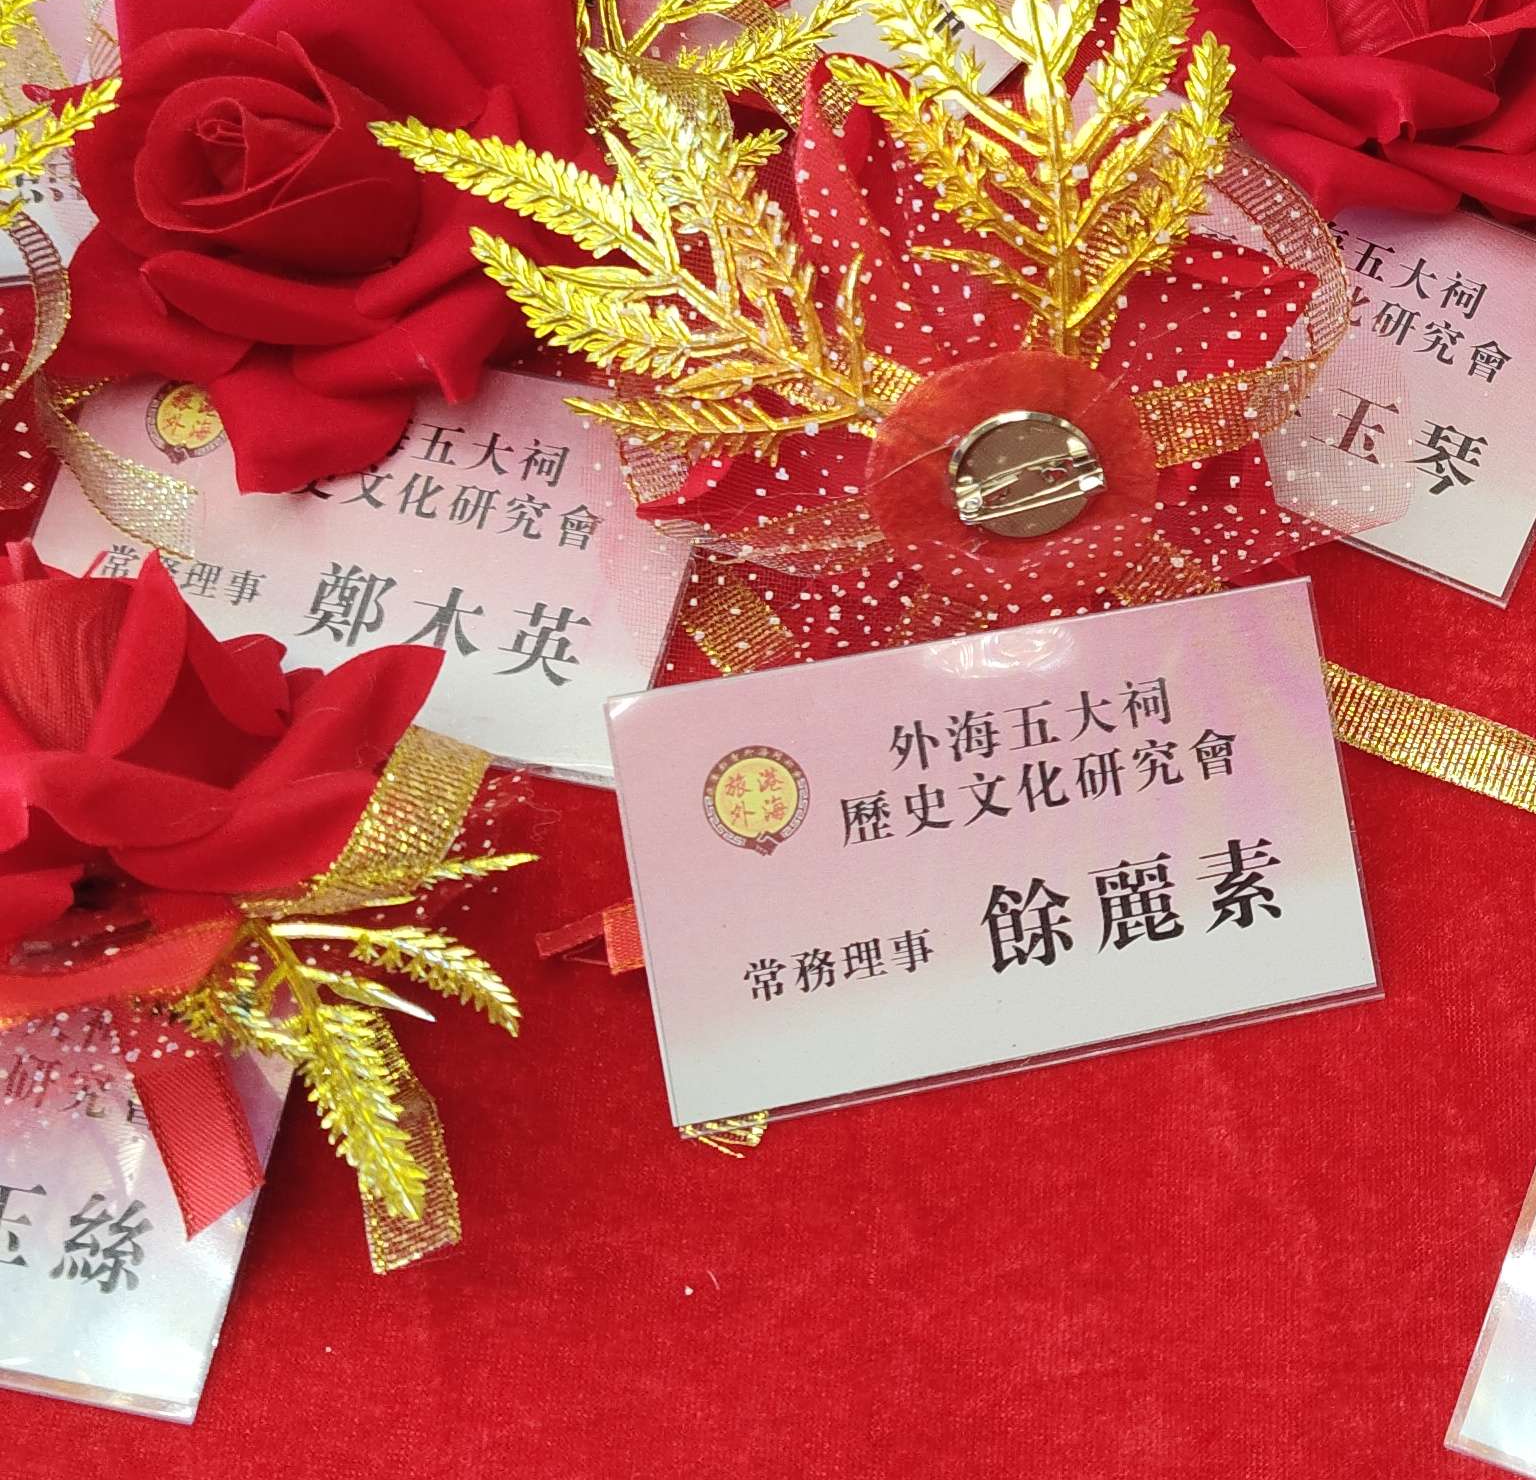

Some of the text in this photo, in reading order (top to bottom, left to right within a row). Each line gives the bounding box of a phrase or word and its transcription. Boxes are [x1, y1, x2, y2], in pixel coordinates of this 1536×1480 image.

[385, 419, 571, 488] 五大祠
[1309, 387, 1489, 496] 玉琴
[103, 544, 267, 606] 常理事
[295, 562, 593, 686] 鄭木英
[889, 676, 1173, 772] 外海五大祠
[840, 729, 1239, 849] 歷史文化研究會
[980, 838, 1284, 975] 餘麗素
[743, 928, 935, 1004] 常務理事
